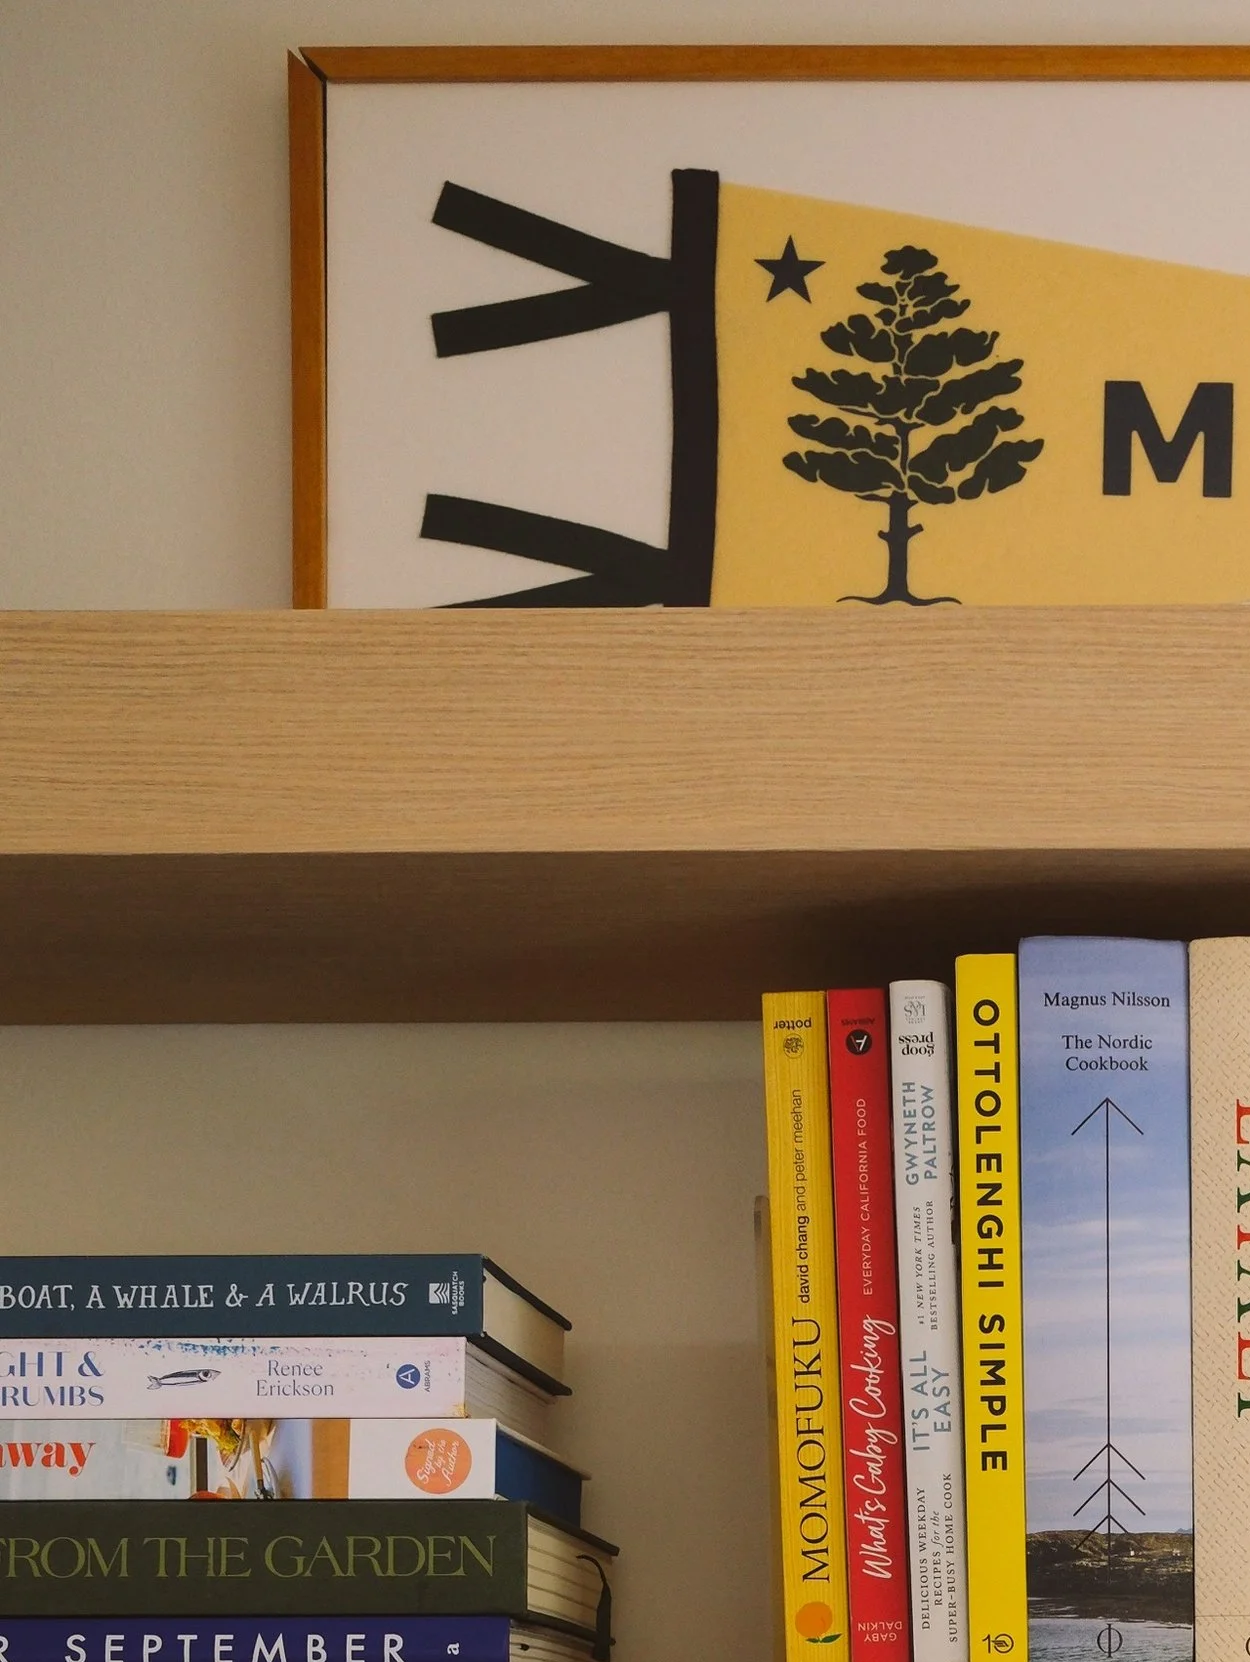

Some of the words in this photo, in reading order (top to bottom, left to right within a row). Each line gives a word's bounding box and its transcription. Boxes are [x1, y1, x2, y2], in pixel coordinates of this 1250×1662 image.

[1043, 991, 1106, 1011] Magnus
[1111, 990, 1170, 1009] Nilsson
[773, 1017, 812, 1030] potter
[898, 1031, 935, 1043] press
[1061, 1034, 1092, 1051] The
[1098, 1033, 1152, 1051] Nordic
[901, 1043, 935, 1057] goop
[1065, 1054, 1148, 1072] Cookbook
[790, 1089, 803, 1144] meehan
[856, 1098, 867, 1136] FOOD
[904, 1081, 919, 1186] GWYNETH
[921, 1085, 938, 1180] PALTROW
[792, 1148, 807, 1179] peter
[974, 997, 1002, 1289] OTTOLENGHI
[794, 1181, 806, 1212] and
[859, 1140, 871, 1221] CALIFORNIA
[795, 1215, 810, 1256] chang
[912, 1206, 921, 1243] TIMES
[925, 1200, 935, 1248] AUTHOR
[796, 1260, 810, 1304] david
[863, 1226, 873, 1296] EVERYDAY
[914, 1248, 923, 1278] YORK
[0, 1285, 76, 1311] BOAT,
[86, 1285, 106, 1309] A
[113, 1285, 214, 1309] WHALE
[225, 1283, 249, 1308] &
[256, 1283, 278, 1307] A
[287, 1281, 410, 1307] WALRUS
[916, 1282, 924, 1309] NEW
[928, 1253, 938, 1330] BESTSELLING
[78, 1351, 106, 1378] &
[266, 1360, 324, 1377] Renee
[849, 1314, 896, 1419] Cooking
[909, 1350, 928, 1395] ALL
[255, 1379, 335, 1397] Erickson
[932, 1367, 952, 1434] EASY
[979, 1312, 1008, 1472] SIMPLE
[791, 1316, 830, 1583] MOMOFUKU
[910, 1407, 930, 1451] IT'S
[416, 1438, 436, 1484] Signed
[441, 1441, 460, 1487] Author
[853, 1421, 898, 1496] Gaby
[942, 1473, 952, 1509] COOK
[853, 1497, 893, 1580] What's
[916, 1487, 927, 1553] WEEKDAY
[930, 1530, 944, 1548] for
[931, 1510, 940, 1527] the
[944, 1514, 955, 1554] HOME
[143, 1537, 251, 1578] THE
[265, 1534, 497, 1579] GARDEN
[932, 1551, 943, 1606] RECIPES
[919, 1558, 930, 1630] DELICIOUS
[946, 1560, 958, 1643] SUPER-BUSY
[857, 1621, 903, 1631] DALKIN
[863, 1631, 897, 1642] GABY
